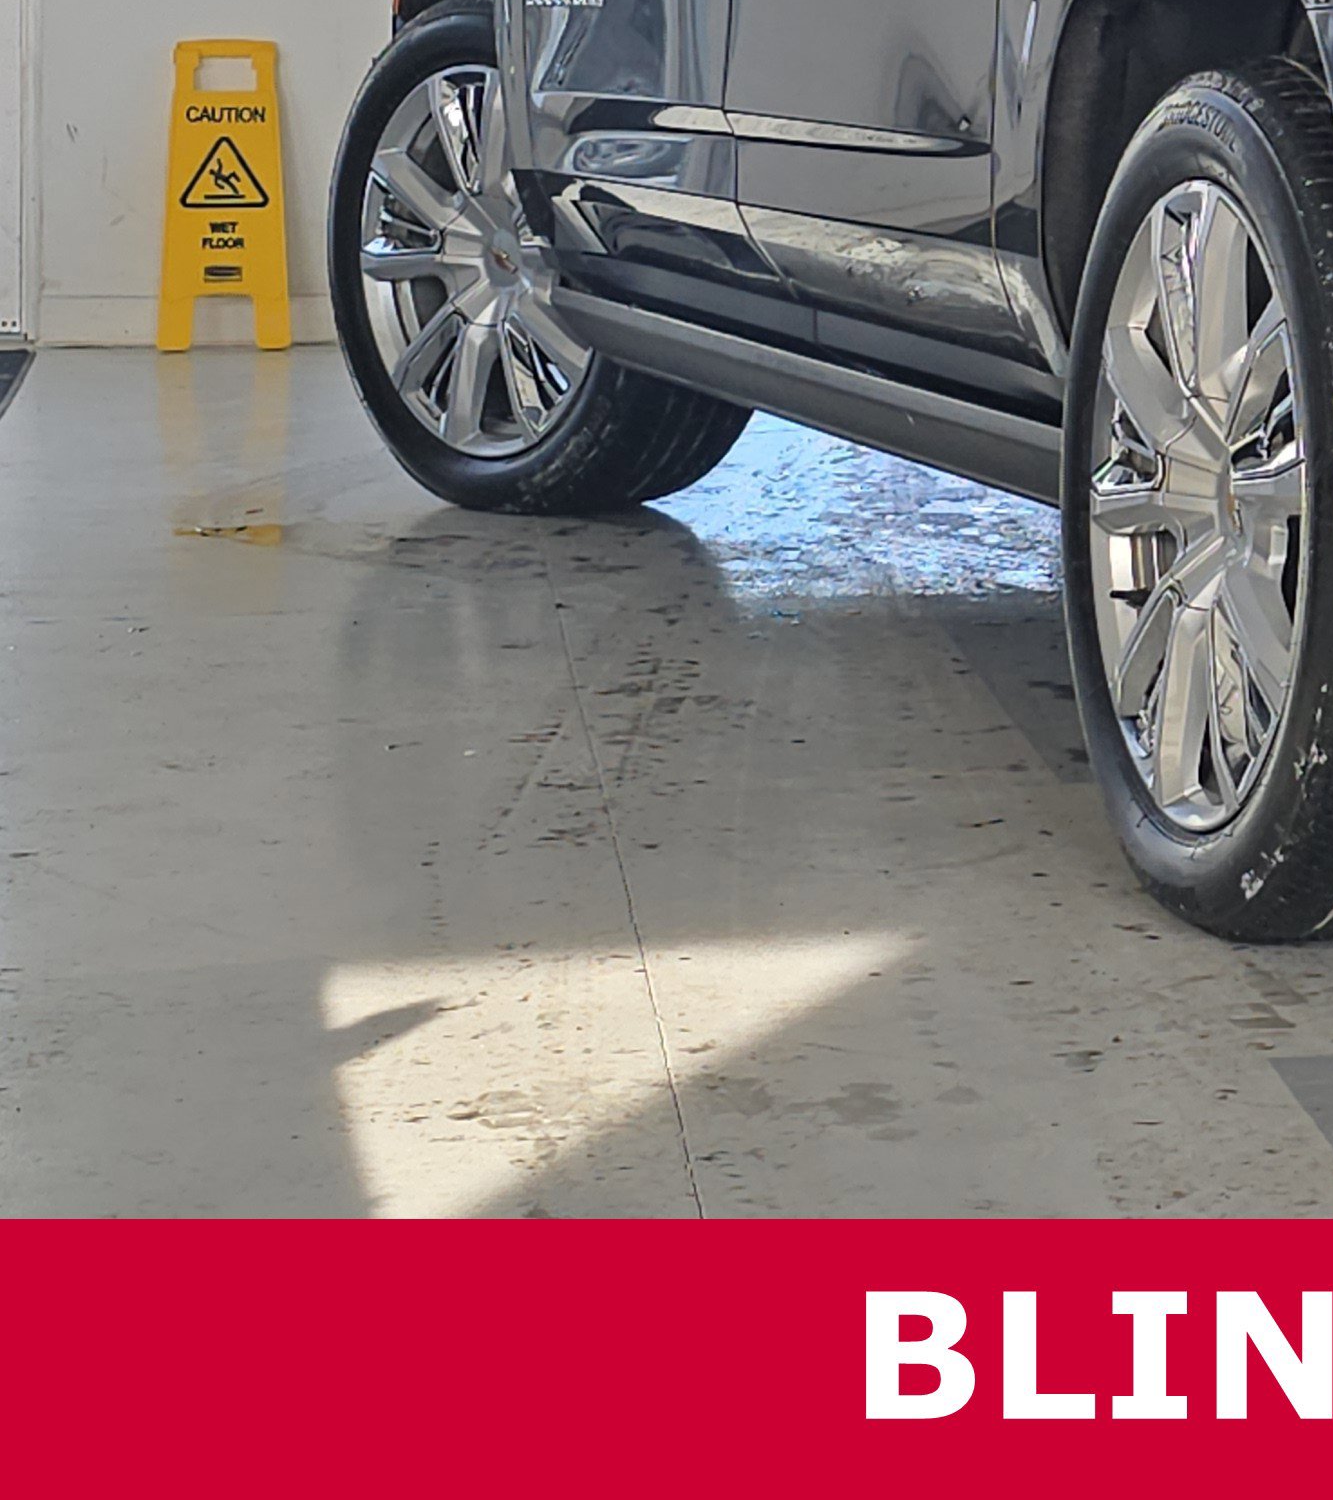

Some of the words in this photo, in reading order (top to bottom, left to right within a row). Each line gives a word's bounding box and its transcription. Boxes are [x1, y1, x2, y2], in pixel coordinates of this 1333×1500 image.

[186, 106, 266, 123] CAUTION
[209, 221, 238, 233] WET
[202, 237, 244, 249] FLOOR
